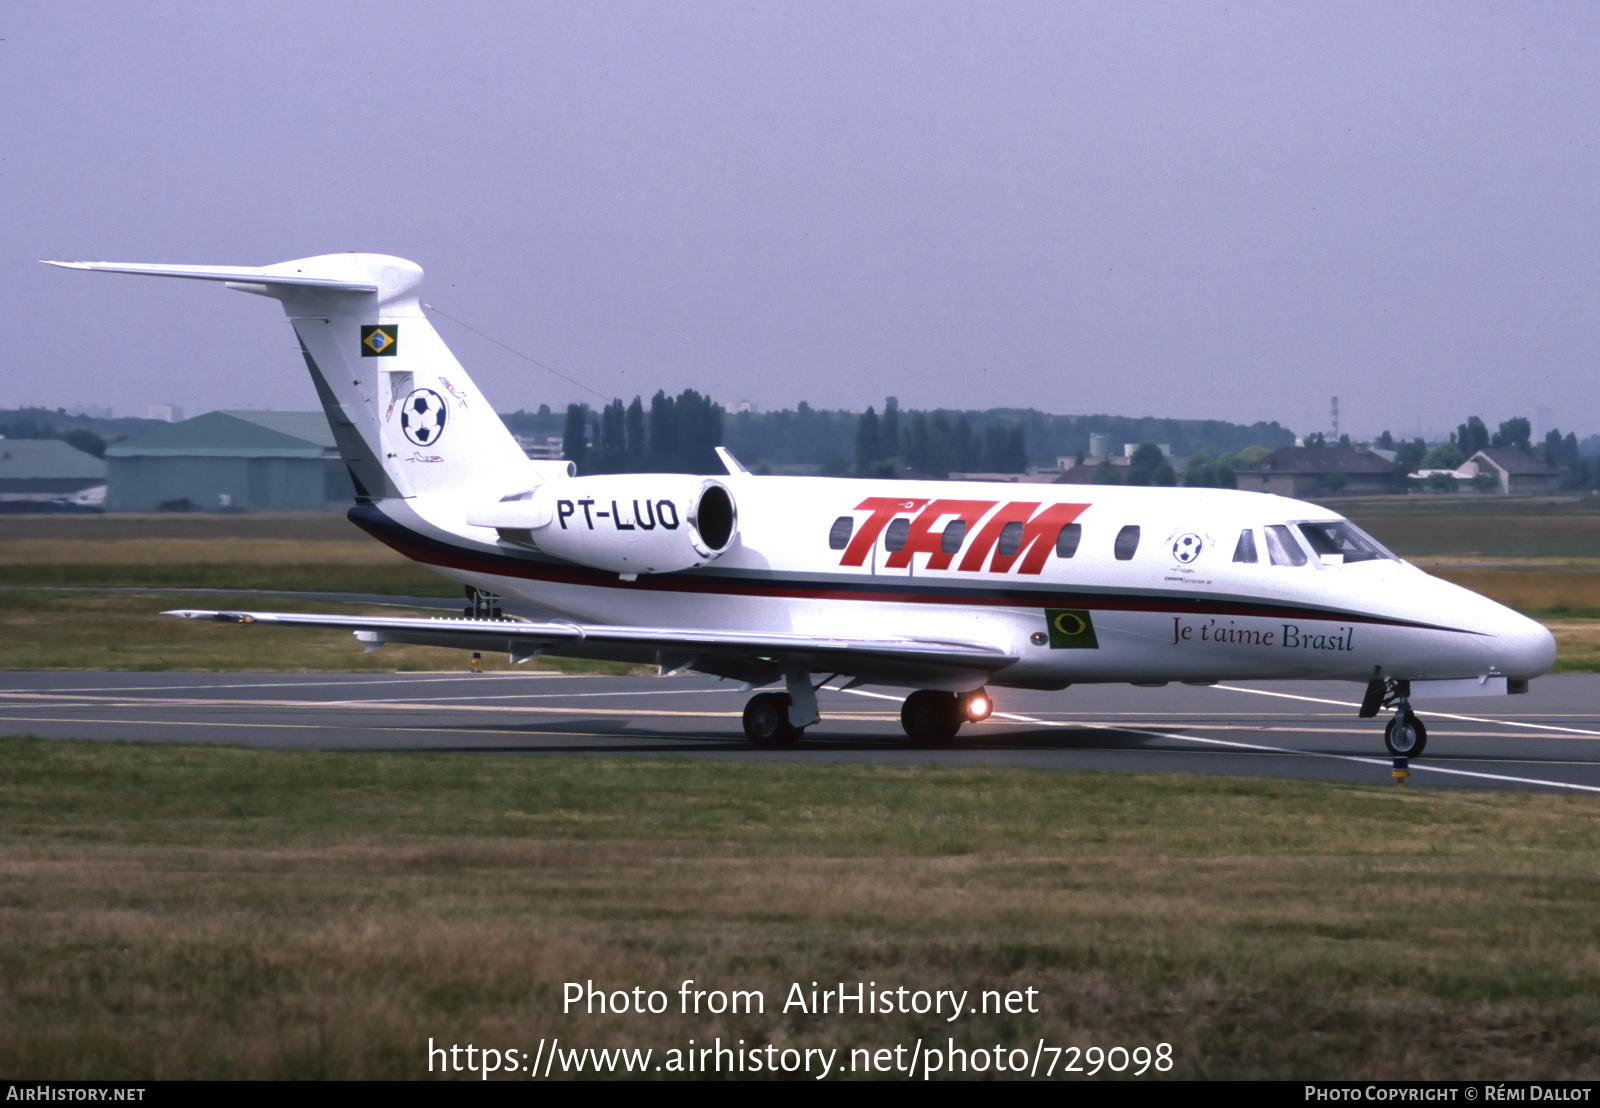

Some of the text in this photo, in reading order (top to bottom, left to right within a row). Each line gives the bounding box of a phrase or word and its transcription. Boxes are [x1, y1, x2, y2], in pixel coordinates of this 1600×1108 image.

[557, 499, 680, 531] PT-LUO
[838, 496, 1094, 576] TAM
[1172, 616, 1355, 652] Je t’aime Brasil
